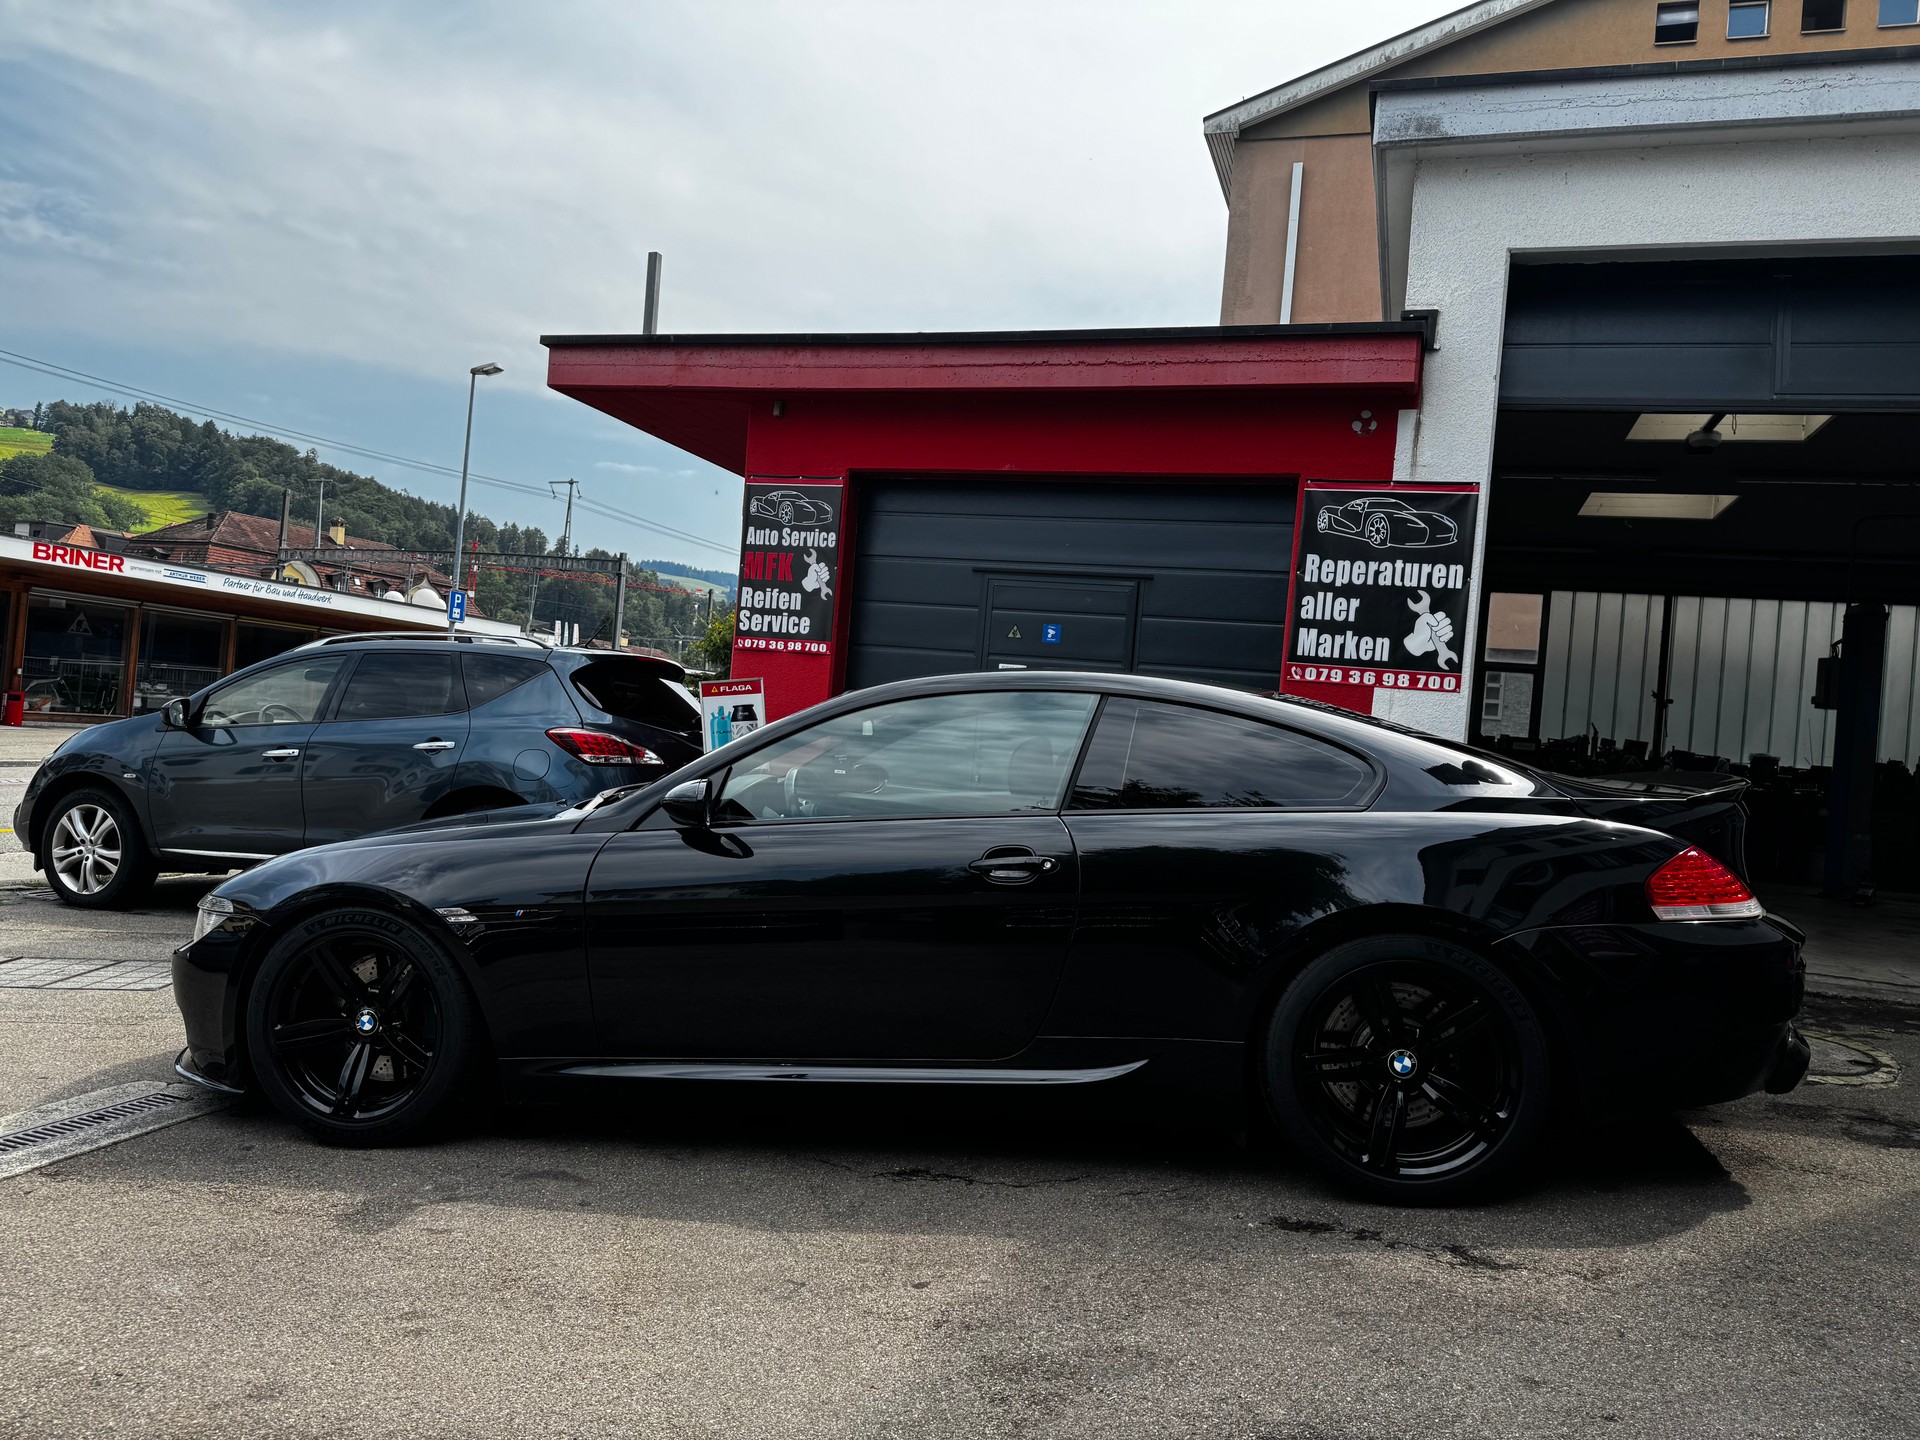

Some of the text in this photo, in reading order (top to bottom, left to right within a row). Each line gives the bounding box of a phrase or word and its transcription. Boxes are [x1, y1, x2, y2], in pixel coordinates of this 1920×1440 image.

[746, 526, 837, 548] Auto Service
[33, 542, 124, 573] BRINER
[744, 551, 794, 581] MFK
[1304, 553, 1464, 589] Reperaturen
[223, 577, 333, 604] Partner für Bau und Handwerk
[454, 593, 462, 608] P
[741, 586, 801, 610] Reifen
[1300, 591, 1360, 622] aller
[739, 610, 810, 634] Service
[744, 638, 827, 653] 079 36 98 700
[1296, 627, 1390, 662] Marken
[720, 684, 752, 693] FLAGA
[1304, 667, 1457, 690] 079 36 98 700
[324, 913, 401, 932] MICHELIN
